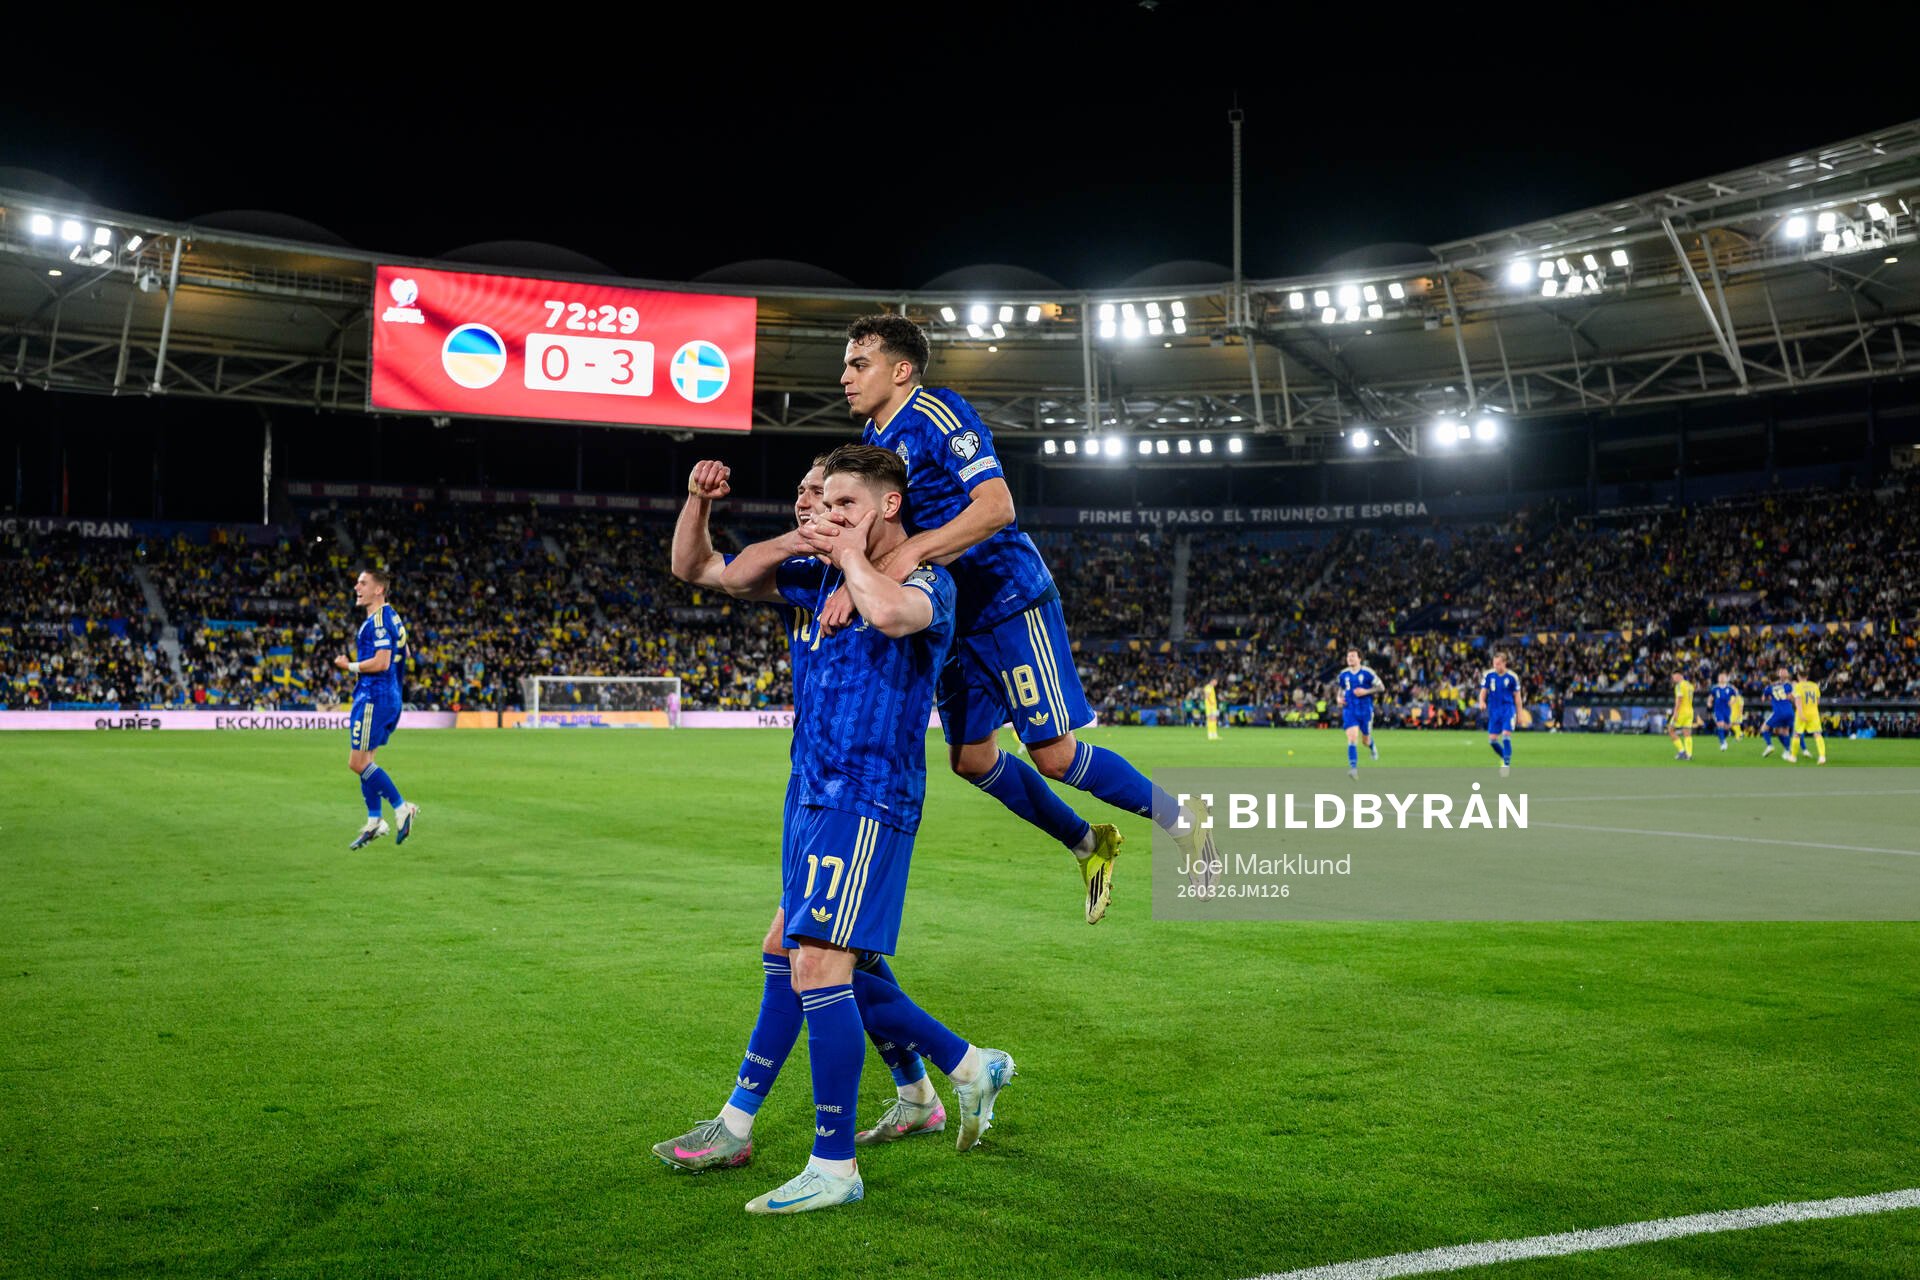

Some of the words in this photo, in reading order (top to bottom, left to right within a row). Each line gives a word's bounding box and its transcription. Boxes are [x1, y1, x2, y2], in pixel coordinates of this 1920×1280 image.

[544, 300, 640, 334] 72:29
[541, 344, 570, 382] 0
[610, 349, 635, 385] 3
[1078, 510, 1133, 524] FIRME
[1137, 510, 1161, 524] TU
[1167, 509, 1214, 523] PASO
[1223, 509, 1244, 522] EL
[1333, 505, 1356, 519] TE
[1001, 664, 1041, 709] 18
[1805, 691, 1816, 705] 14
[353, 720, 361, 737] 2
[804, 855, 845, 900] 17
